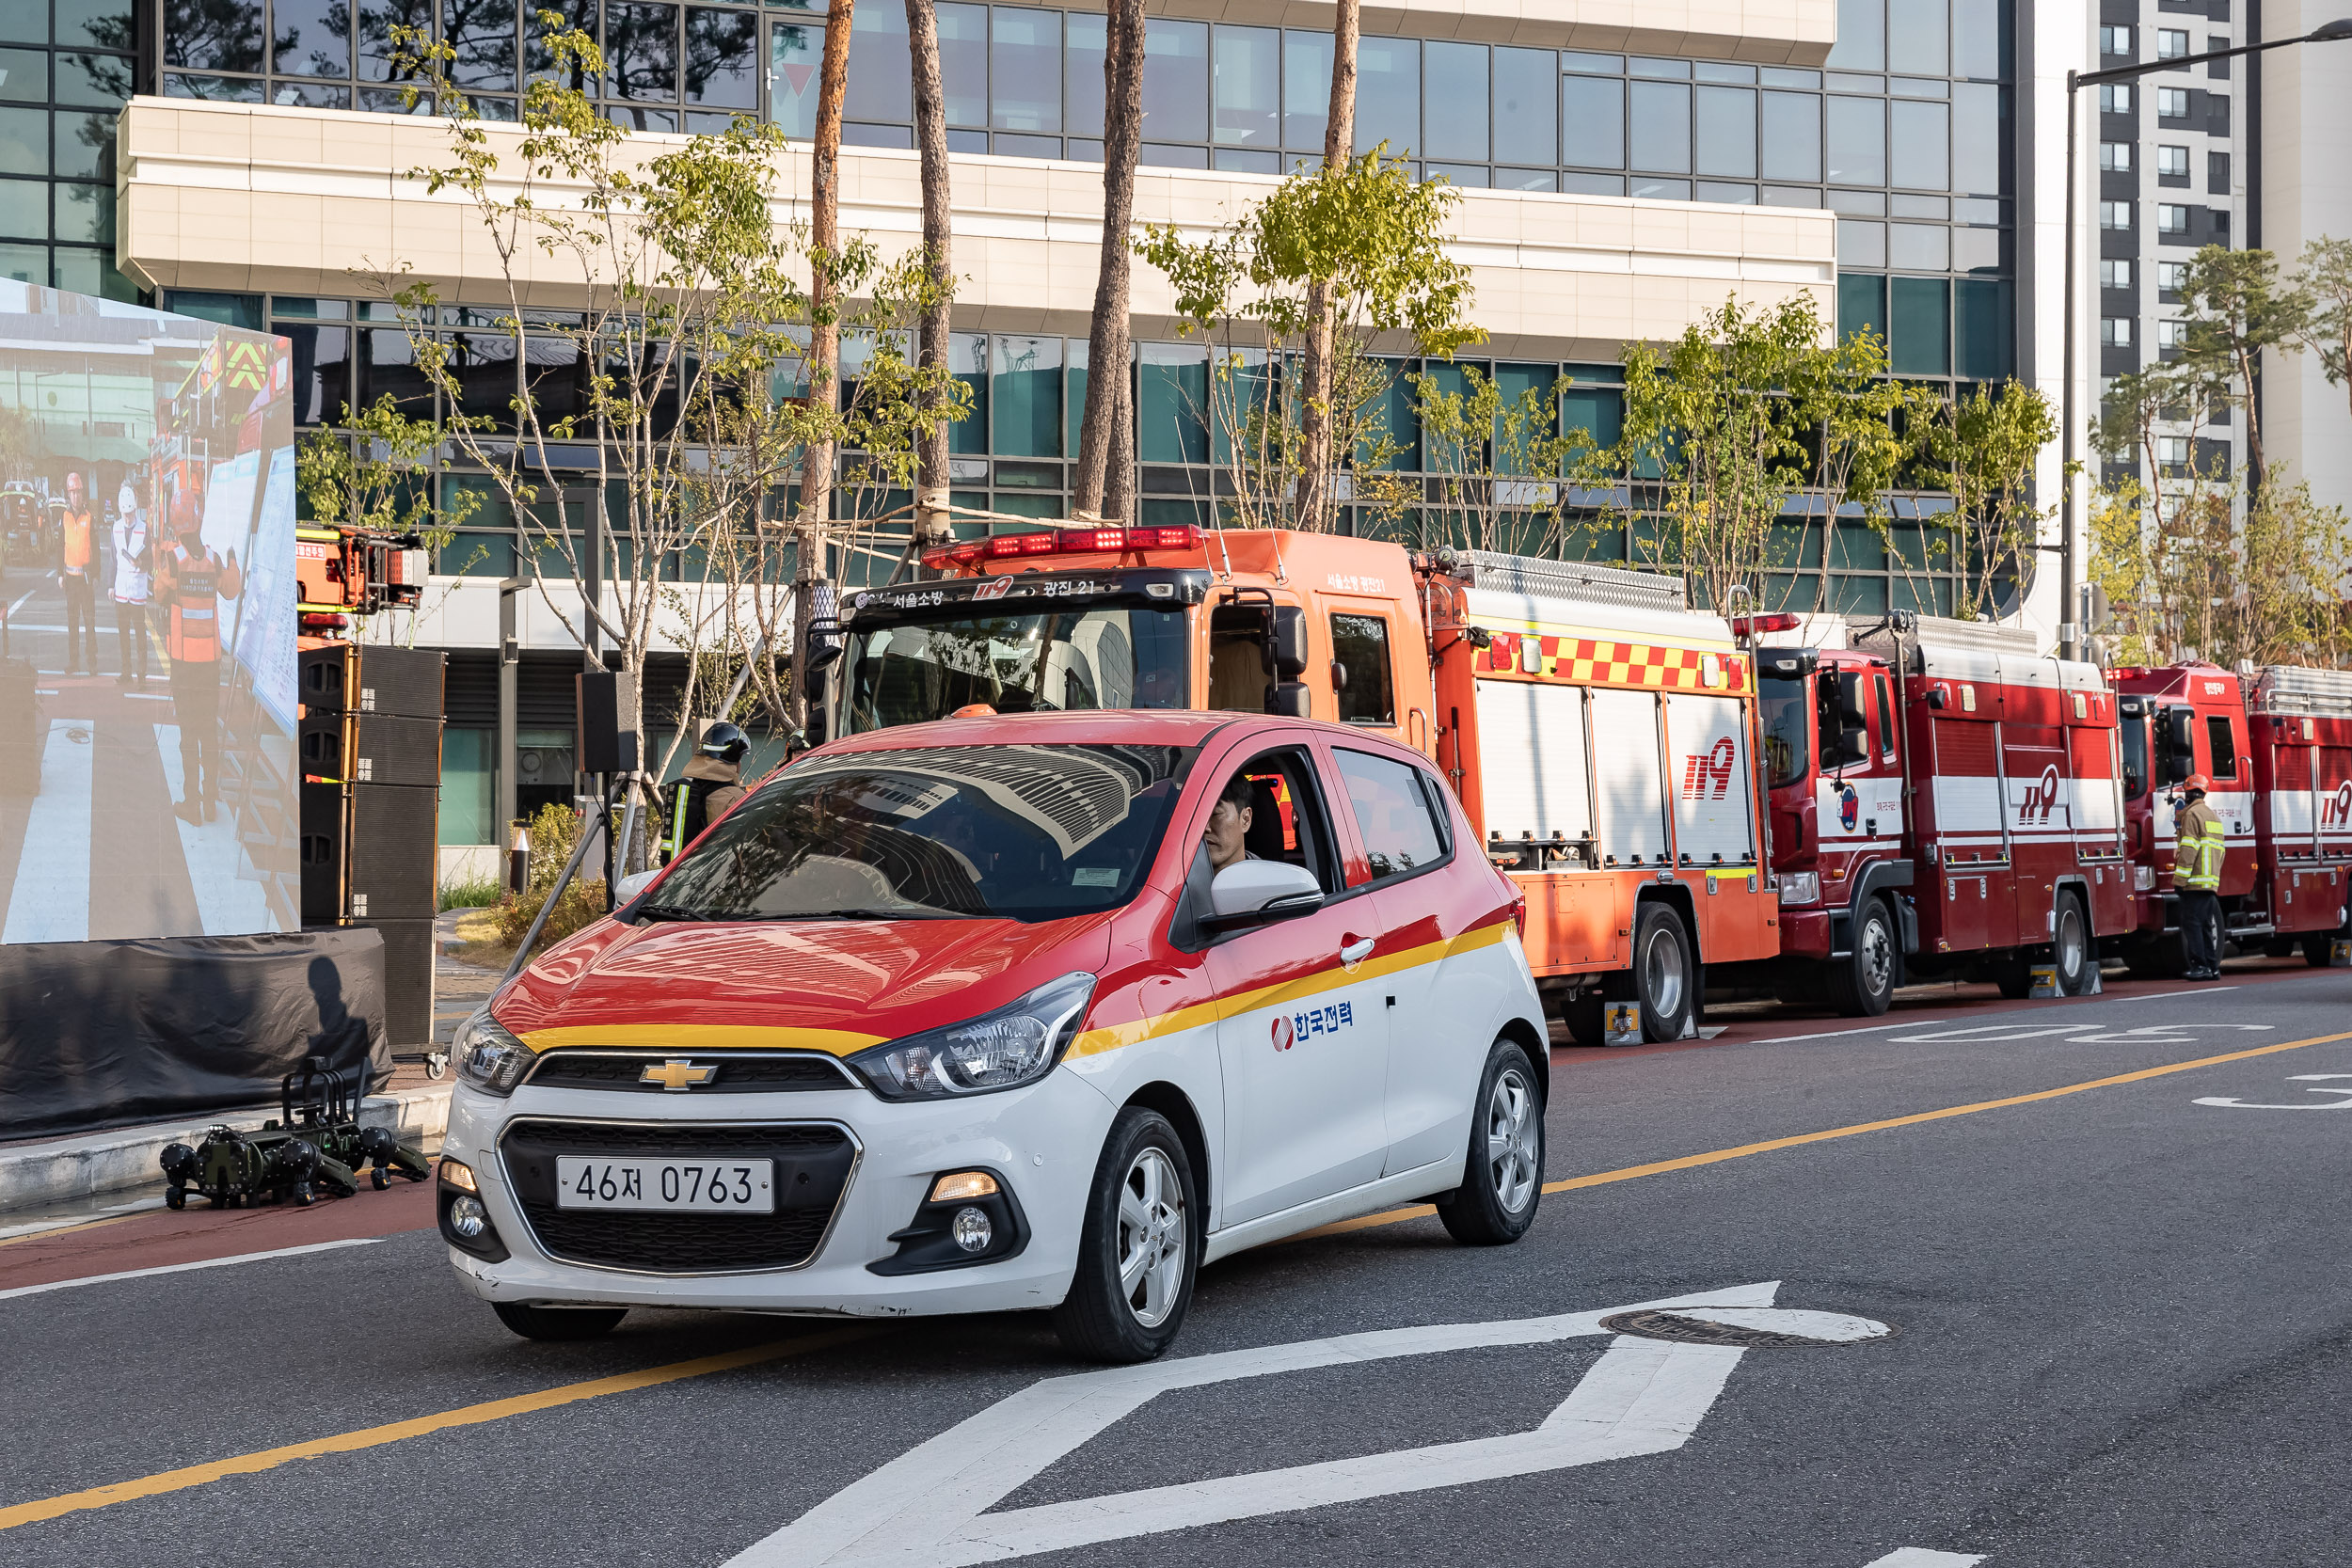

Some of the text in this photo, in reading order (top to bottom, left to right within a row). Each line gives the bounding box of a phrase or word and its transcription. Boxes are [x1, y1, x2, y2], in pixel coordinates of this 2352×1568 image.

[893, 591, 944, 610] 서울소방
[972, 576, 1013, 601] 119
[1043, 580, 1072, 597] 광진
[1078, 580, 1095, 594] 21
[1327, 573, 1386, 593] 서울소방 광진21
[1681, 736, 1735, 800] 119
[1842, 796, 1859, 821] 119
[2018, 765, 2058, 825] 119
[2321, 782, 2352, 829] 119
[1295, 1001, 1353, 1042] 한국전력
[576, 1164, 753, 1204] 46저 0763
